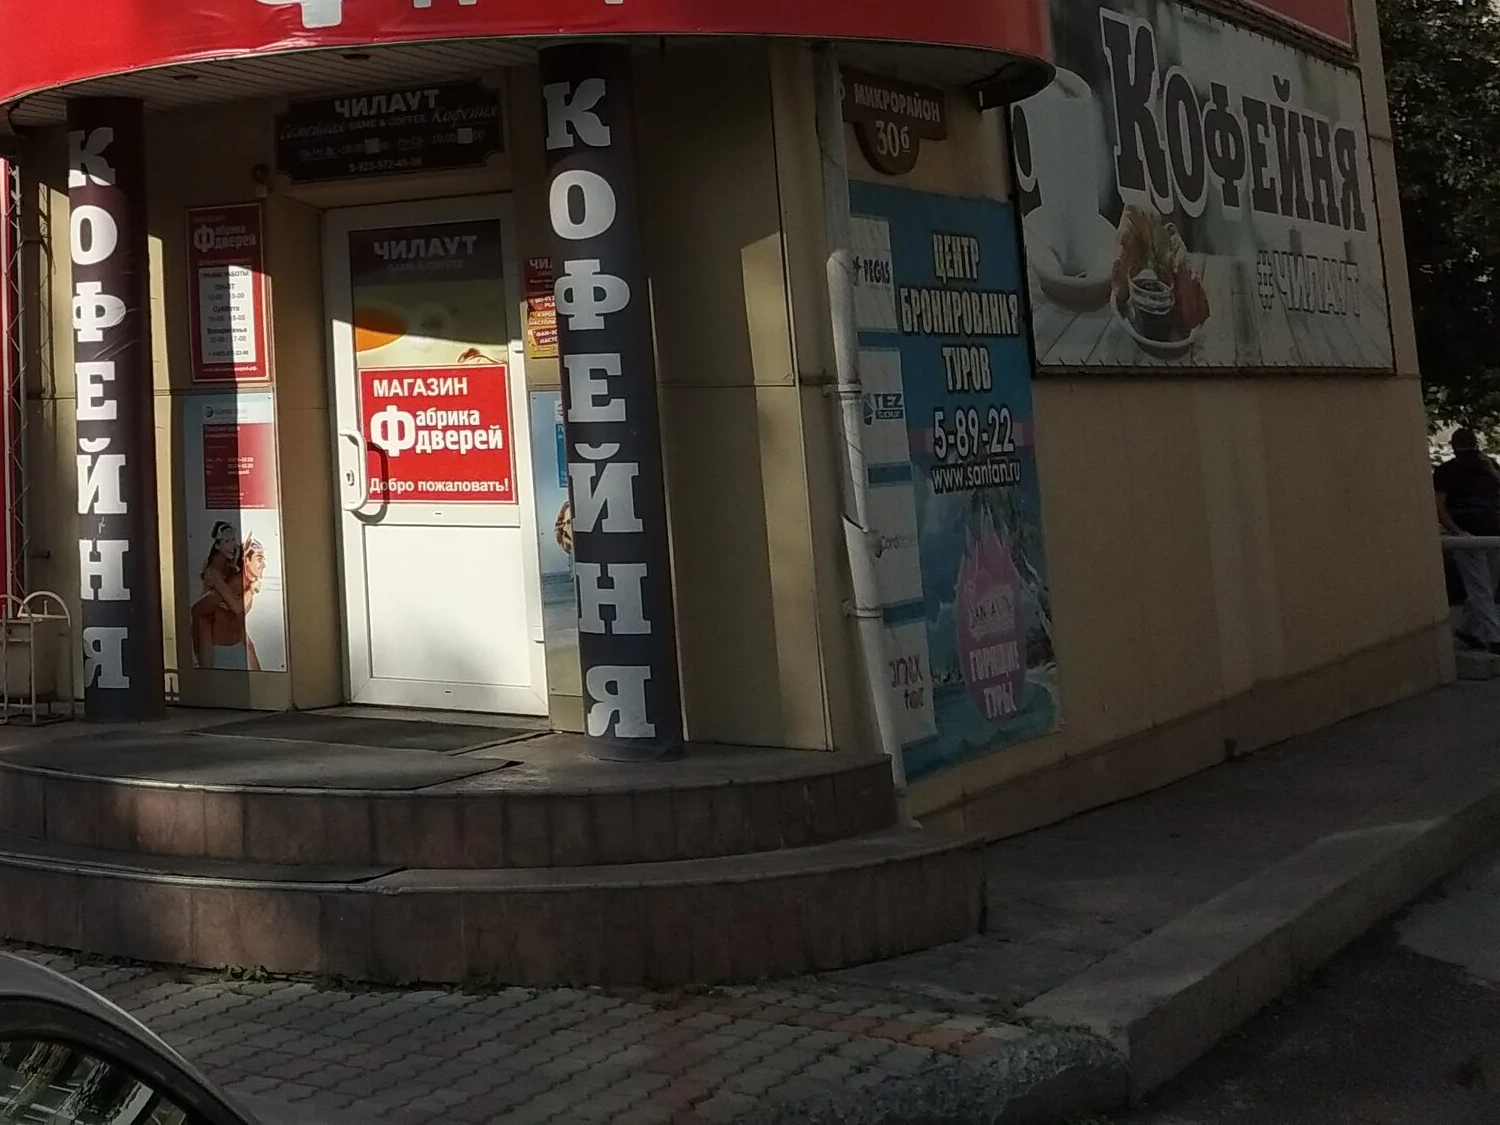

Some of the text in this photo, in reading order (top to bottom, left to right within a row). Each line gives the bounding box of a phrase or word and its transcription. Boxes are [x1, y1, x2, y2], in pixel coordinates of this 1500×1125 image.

[334, 88, 440, 118] ЧИЛАУТ
[853, 83, 941, 122] МИКРОРАЙОН
[1100, 7, 1367, 232] КОФЕЙНЯ
[374, 235, 477, 259] ЧИЛАУТ
[933, 234, 980, 280] ЦЕНТР
[901, 288, 1019, 335] БРОНИРОВАНИЯ
[373, 377, 468, 397] МАГАЗИН
[942, 347, 992, 392] ТУРОВ
[67, 127, 132, 689] КОФЕЙНЯ
[542, 77, 658, 739] КОФЕЙНЯ
[873, 394, 903, 409] TEZ
[370, 405, 480, 457] Фабрика
[415, 425, 503, 455] дверей
[934, 407, 1015, 459] 5-89-22
[369, 477, 510, 494] Добро пожаловать!
[931, 459, 1021, 493] www.santan.ru
